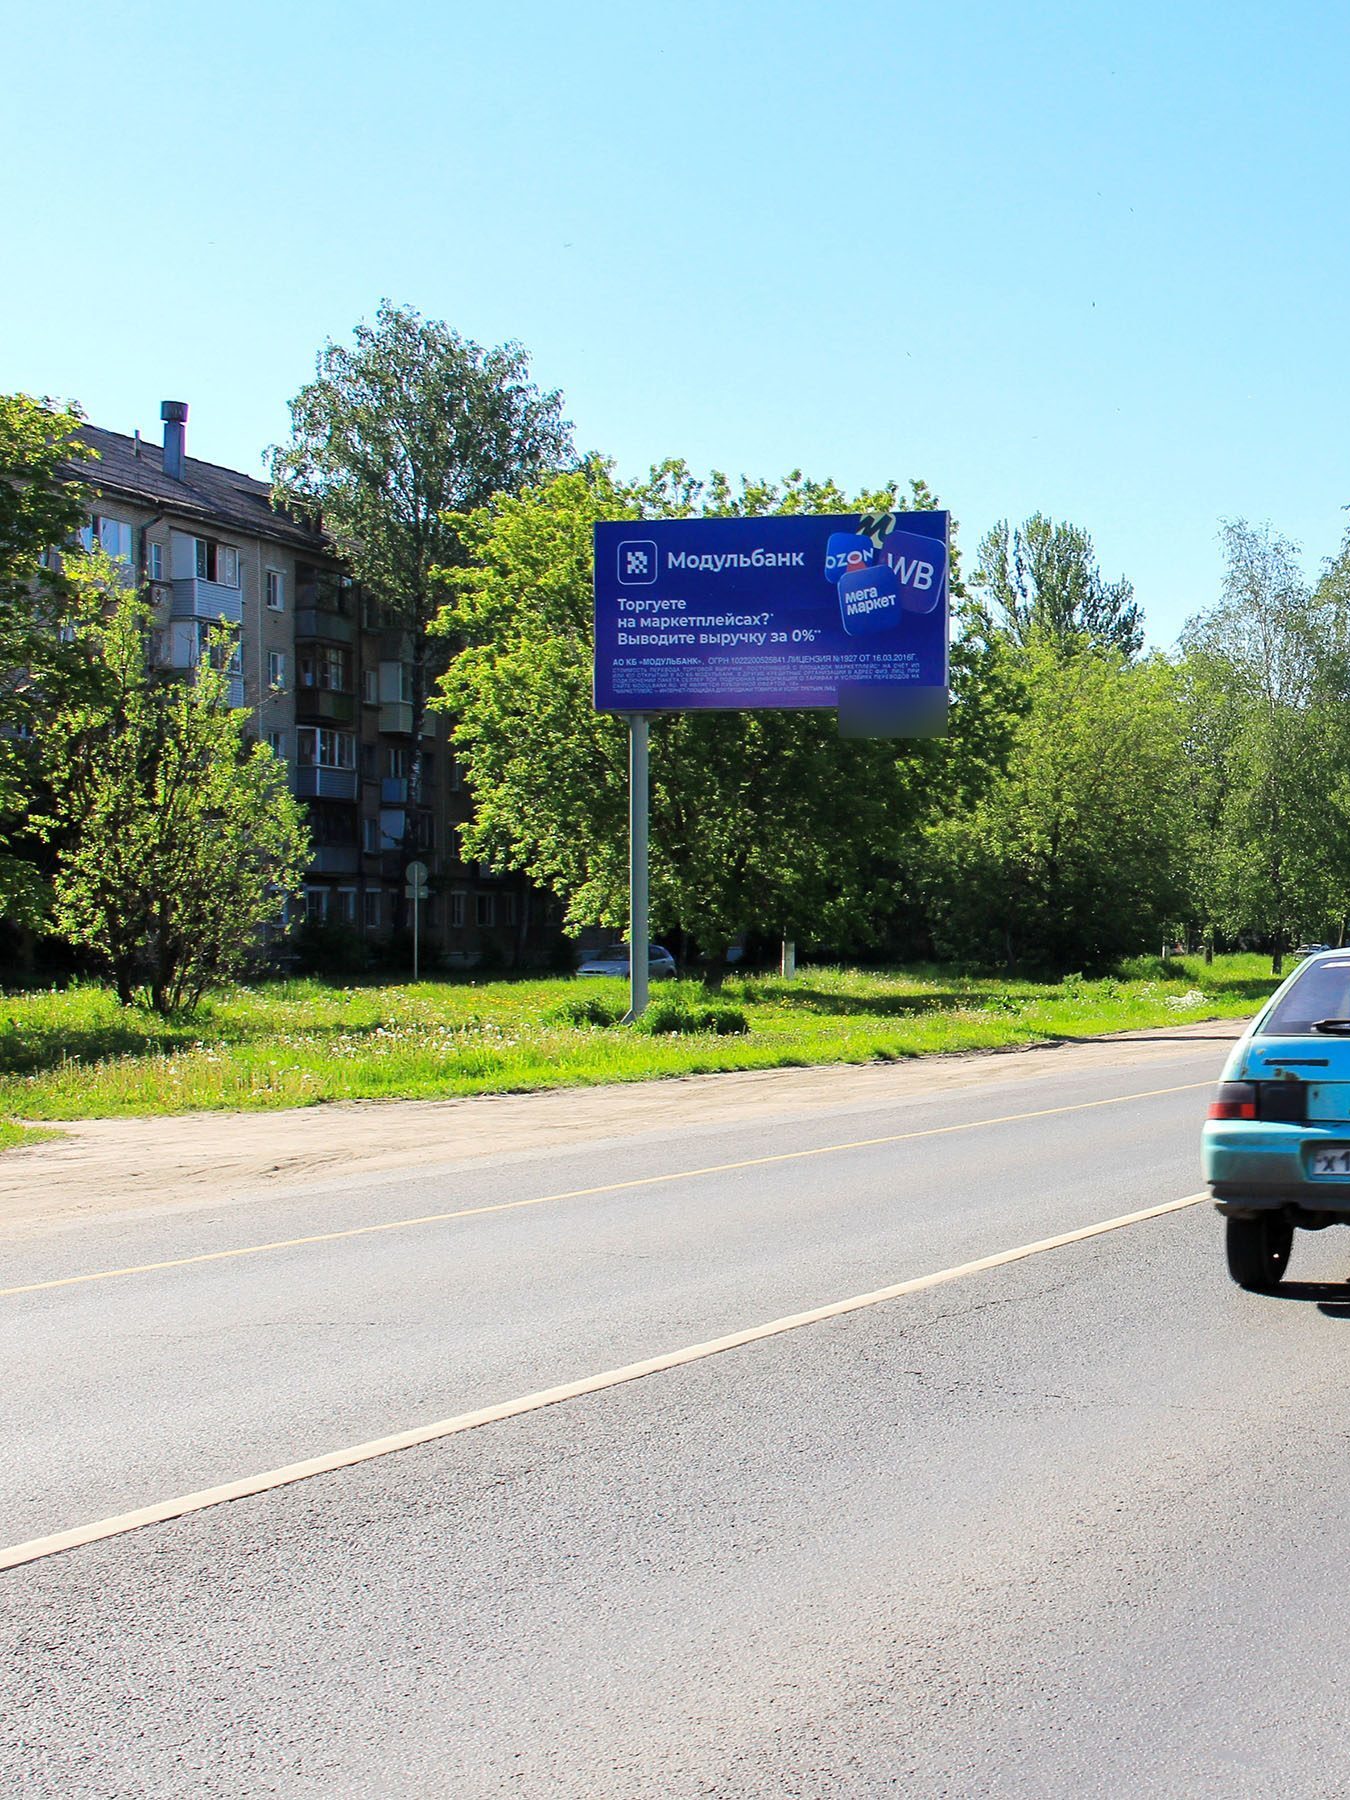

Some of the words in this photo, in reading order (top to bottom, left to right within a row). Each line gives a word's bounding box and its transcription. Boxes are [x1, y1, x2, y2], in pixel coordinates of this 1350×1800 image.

[667, 548, 805, 573] Модульбанк
[826, 548, 874, 569] OZON
[887, 553, 934, 590] WB
[845, 587, 878, 604] мега
[617, 598, 687, 613] Торгуете
[847, 594, 896, 615] маркет
[617, 617, 636, 628] на
[617, 632, 696, 646] Выводите
[699, 631, 767, 646] выручку
[770, 632, 788, 642] за
[612, 658, 625, 666] АО
[626, 658, 637, 666] КБ
[708, 656, 729, 665] ОГРН
[787, 655, 832, 664] ЛИЦЕНЗИЯ
[858, 654, 871, 662] ОТ
